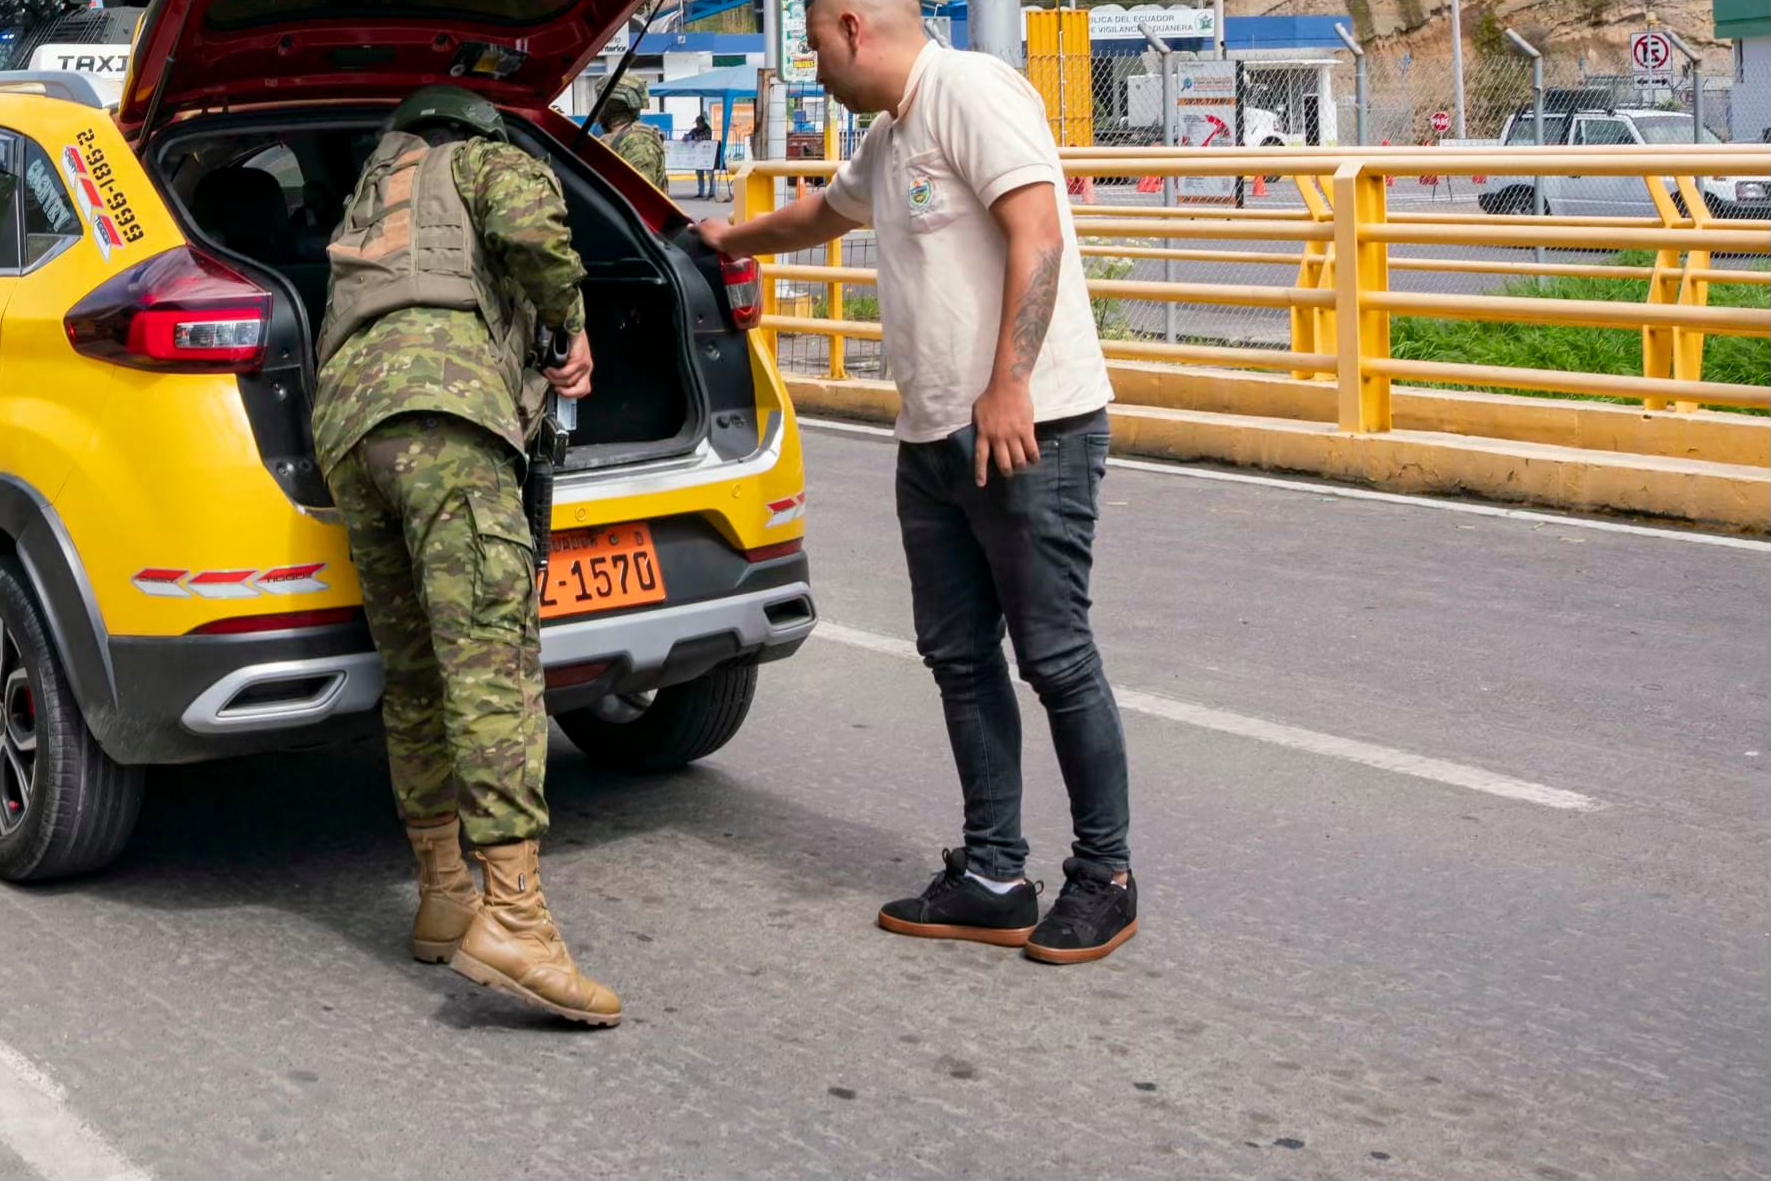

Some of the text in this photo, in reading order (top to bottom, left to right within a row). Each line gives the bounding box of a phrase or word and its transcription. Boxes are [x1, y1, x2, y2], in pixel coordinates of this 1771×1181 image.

[1115, 15, 1129, 23] DEL
[1133, 15, 1175, 23] ECUADOR
[1099, 26, 1146, 34] VIGILANC
[1149, 24, 1193, 33] DUANERA
[76, 128, 144, 244] 2-981-999
